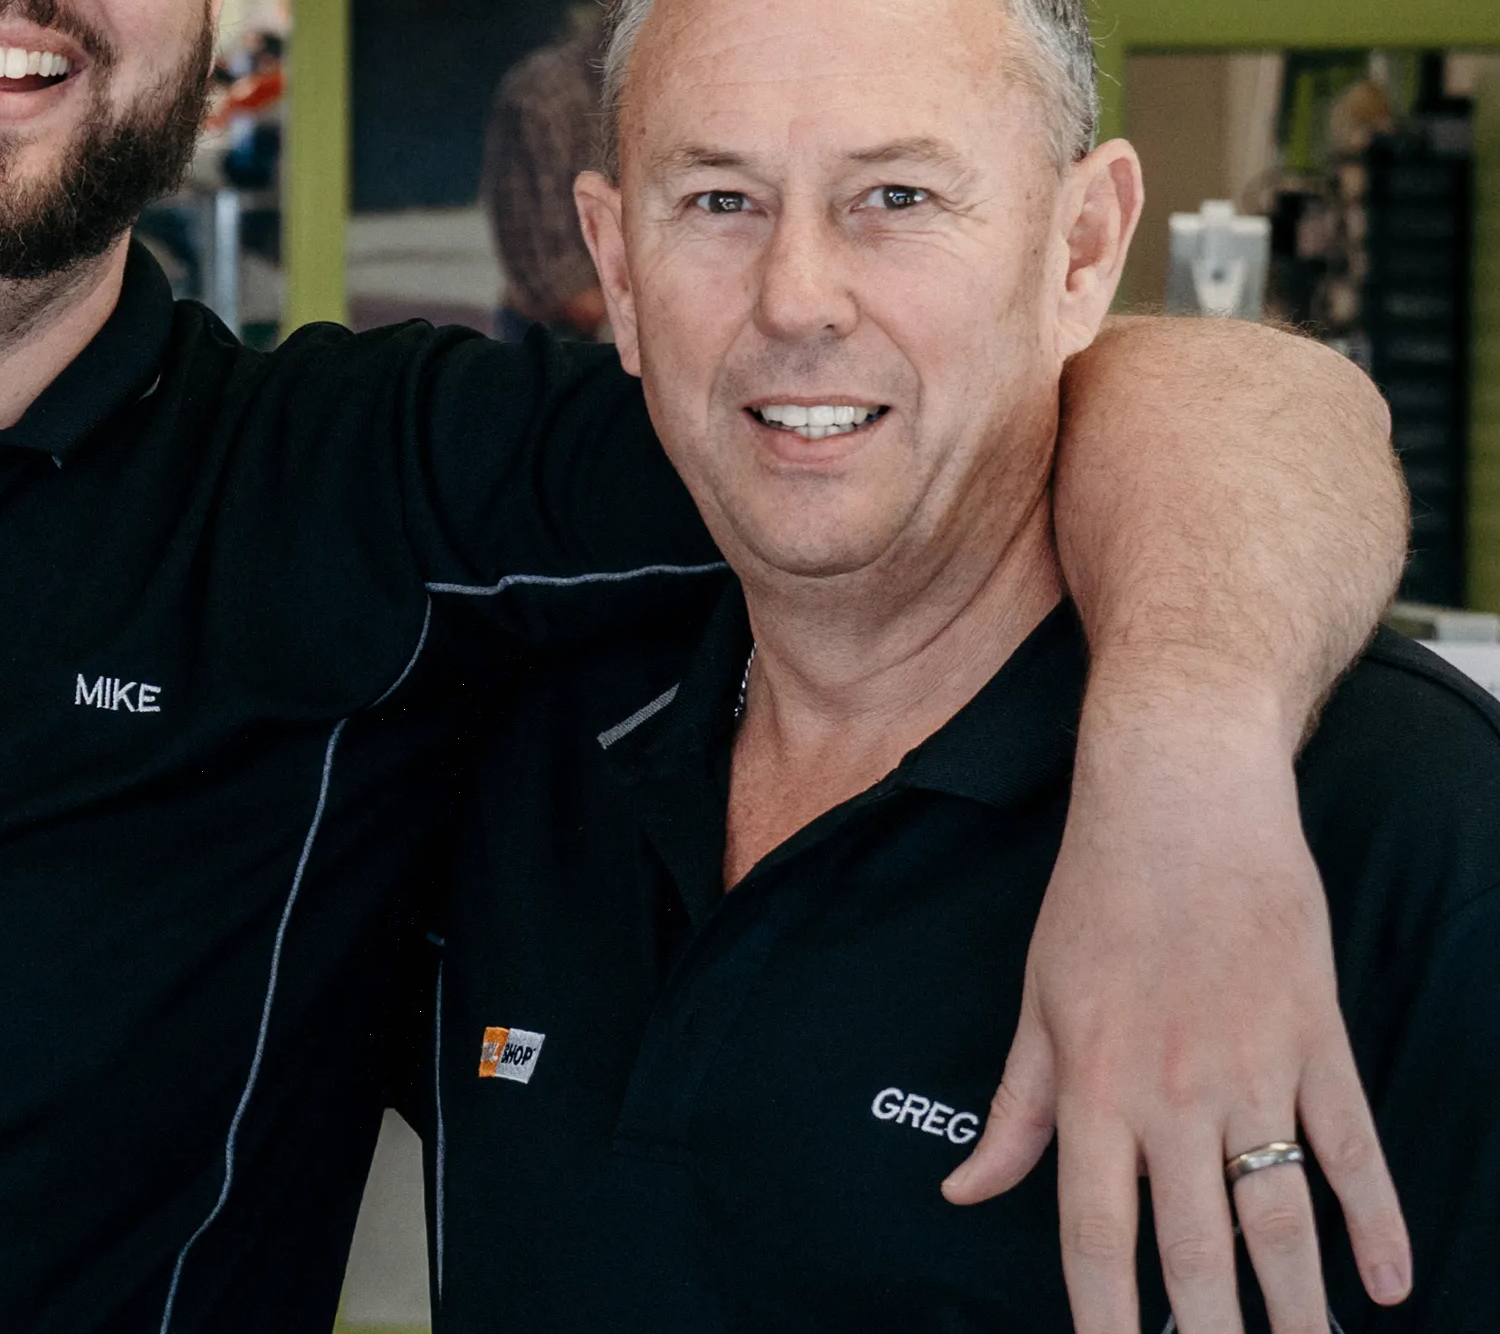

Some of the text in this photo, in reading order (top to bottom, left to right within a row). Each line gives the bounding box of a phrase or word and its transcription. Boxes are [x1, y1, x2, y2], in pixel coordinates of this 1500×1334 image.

[74, 673, 162, 713] MIKE
[501, 1043, 534, 1066] SHOP
[871, 1087, 979, 1144] GREG
